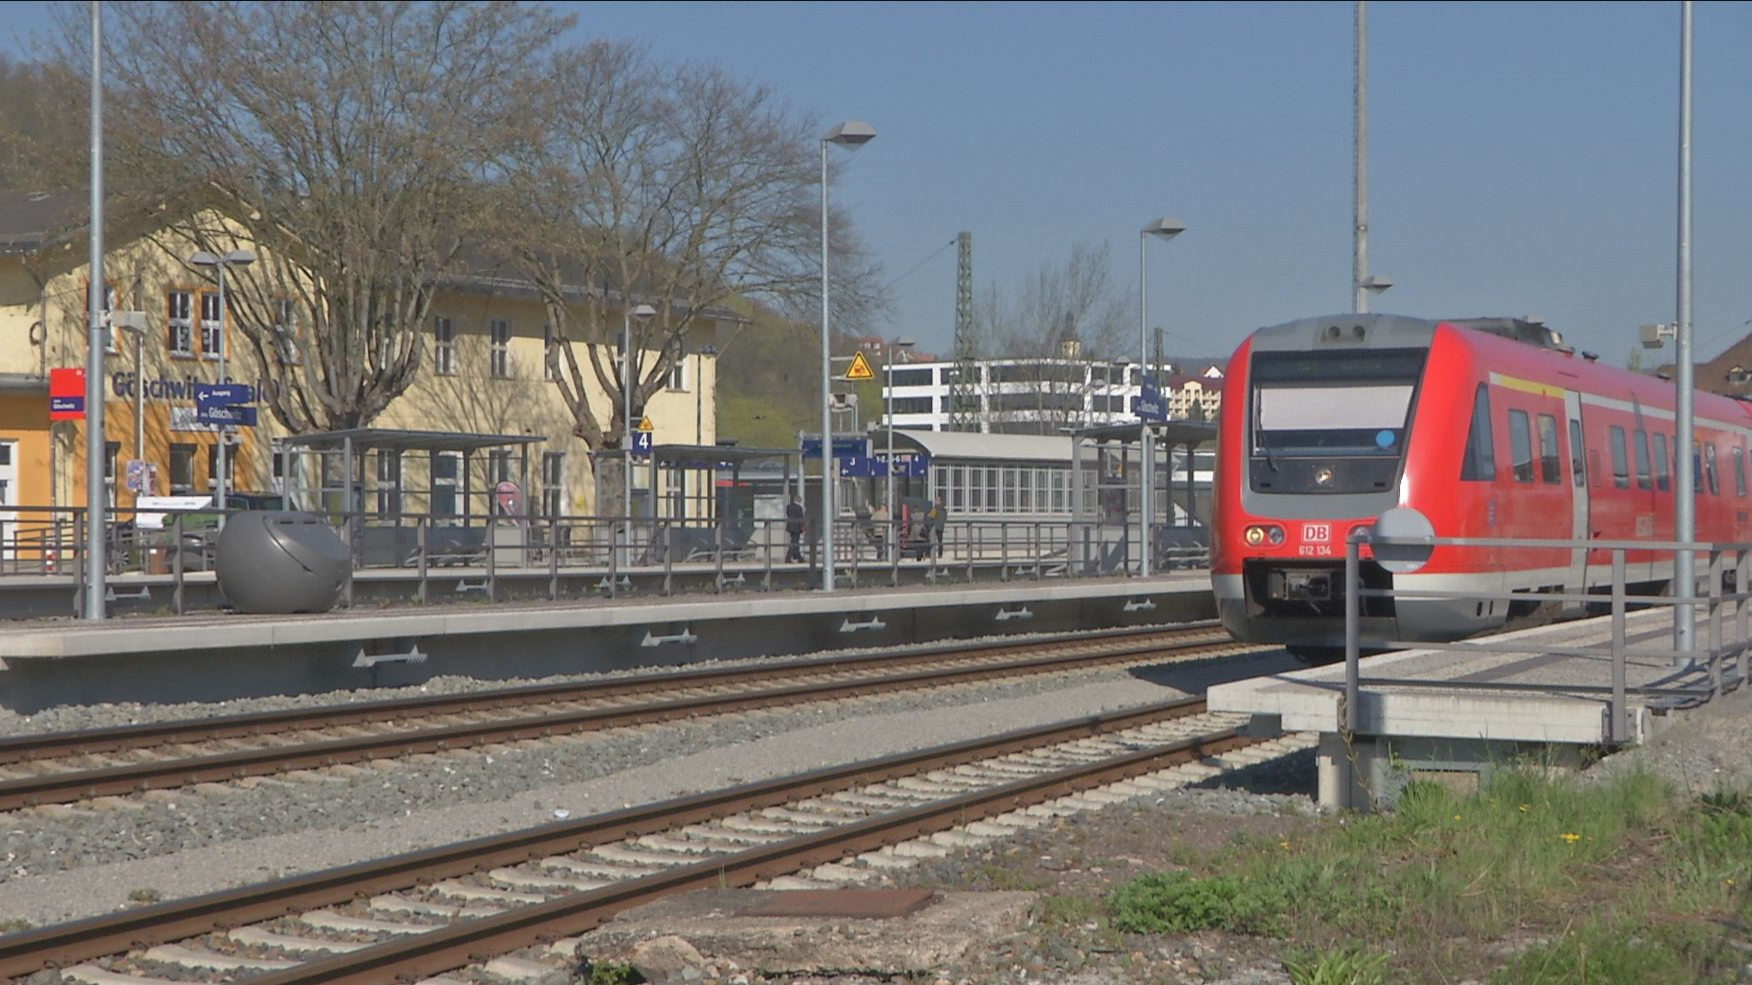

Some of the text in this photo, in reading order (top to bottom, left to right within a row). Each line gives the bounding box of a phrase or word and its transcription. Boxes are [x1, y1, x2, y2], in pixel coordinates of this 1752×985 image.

[639, 433, 649, 449] 4
[849, 457, 856, 466] 3
[1305, 526, 1327, 540] DB
[1299, 545, 1313, 555] 612
